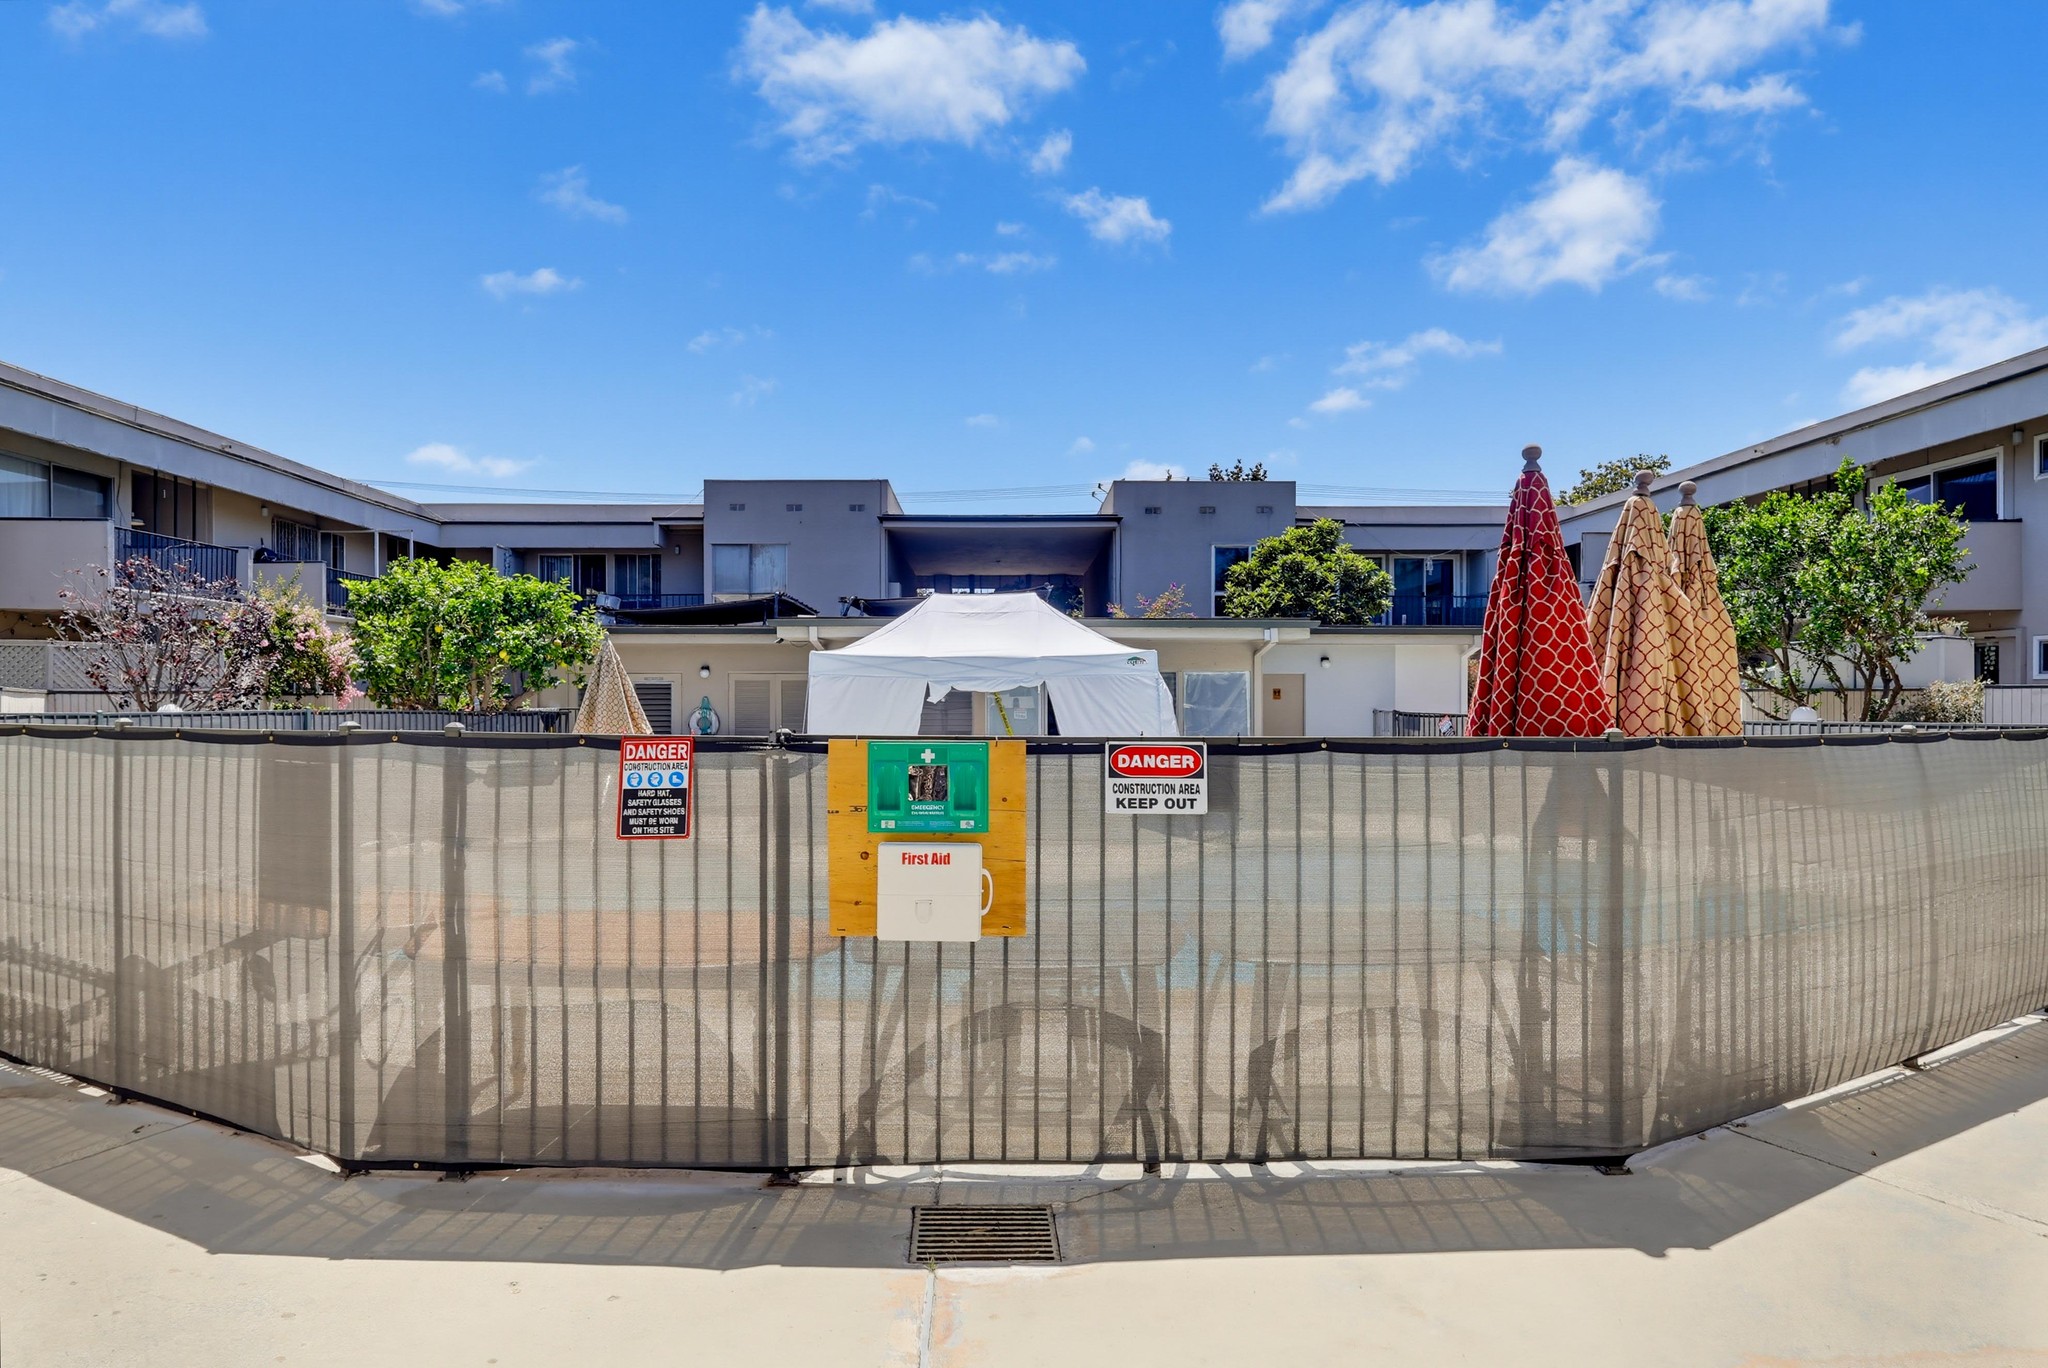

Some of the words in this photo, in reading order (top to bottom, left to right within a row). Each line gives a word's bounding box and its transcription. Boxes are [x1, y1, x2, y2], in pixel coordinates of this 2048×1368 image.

[625, 744, 688, 760] DANGER
[1117, 754, 1195, 769] DANGER
[624, 762, 671, 771] CONSTRUCTION
[672, 762, 688, 770] AREA
[637, 789, 656, 798] HARD
[1112, 783, 1176, 795] CONSTRUCTION
[1178, 783, 1201, 795] AREA
[627, 799, 652, 807] SAFETY
[652, 798, 682, 806] GLASSES
[1115, 797, 1159, 809] KEEP
[1164, 798, 1198, 810] OUT
[622, 808, 637, 816] AND
[638, 808, 662, 816] SAFETY
[663, 807, 685, 815] SHOES
[629, 817, 647, 825] MUST
[648, 817, 657, 825] BE
[658, 817, 679, 825] WORN
[631, 826, 643, 834] ON
[643, 826, 659, 834] THIS
[659, 826, 675, 834] SITE
[902, 852, 929, 865] First
[931, 852, 951, 865] Aid
